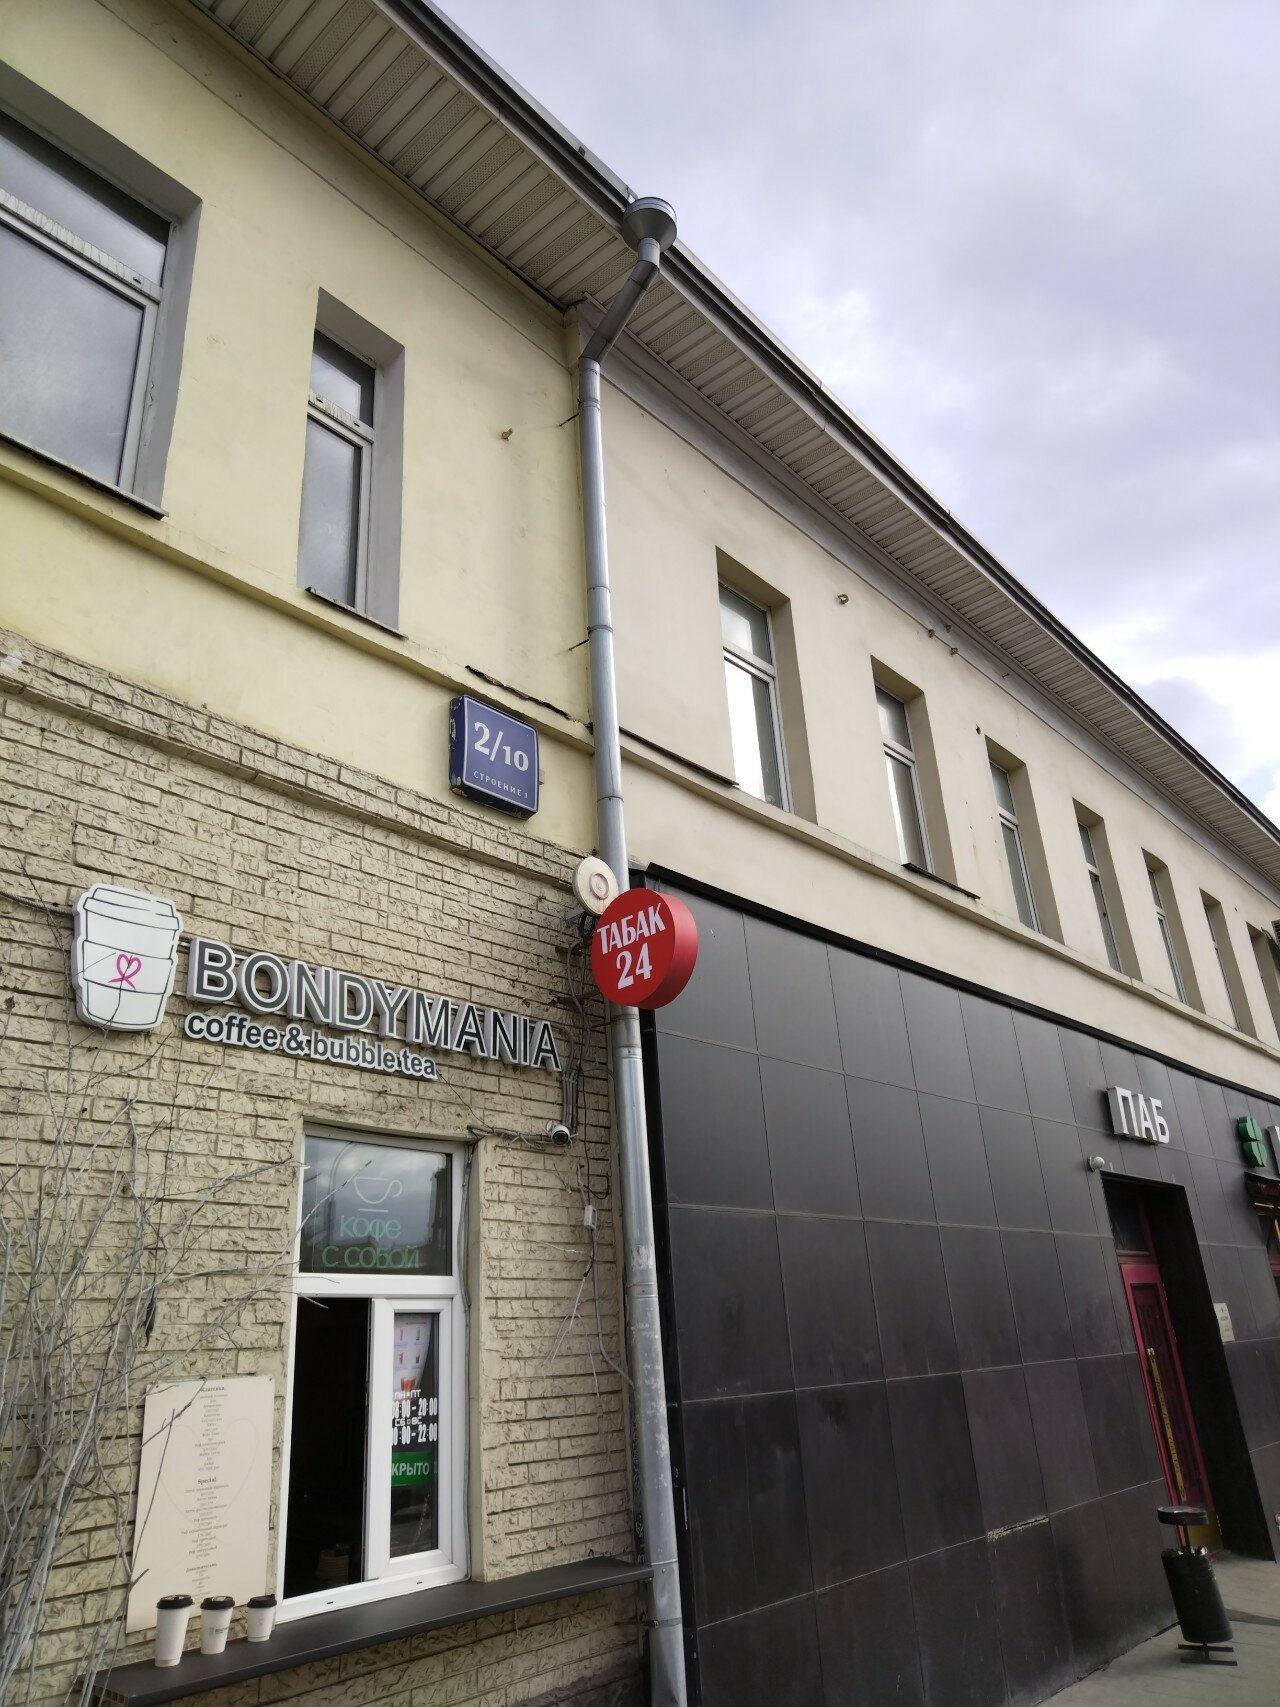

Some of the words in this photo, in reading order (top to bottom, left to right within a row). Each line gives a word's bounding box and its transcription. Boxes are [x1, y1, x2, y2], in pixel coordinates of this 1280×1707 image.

[474, 721, 529, 772] 2/10
[473, 770, 522, 797] СТРОЕНИЕ
[596, 902, 667, 955] ТАБАК
[615, 942, 653, 990] 24
[192, 937, 562, 1072] BONDYMANIA
[186, 1013, 280, 1050] coffee
[284, 1024, 308, 1056] &
[311, 1029, 398, 1072] bubble
[400, 1049, 438, 1080] tea
[1110, 1086, 1170, 1144] ПАБ
